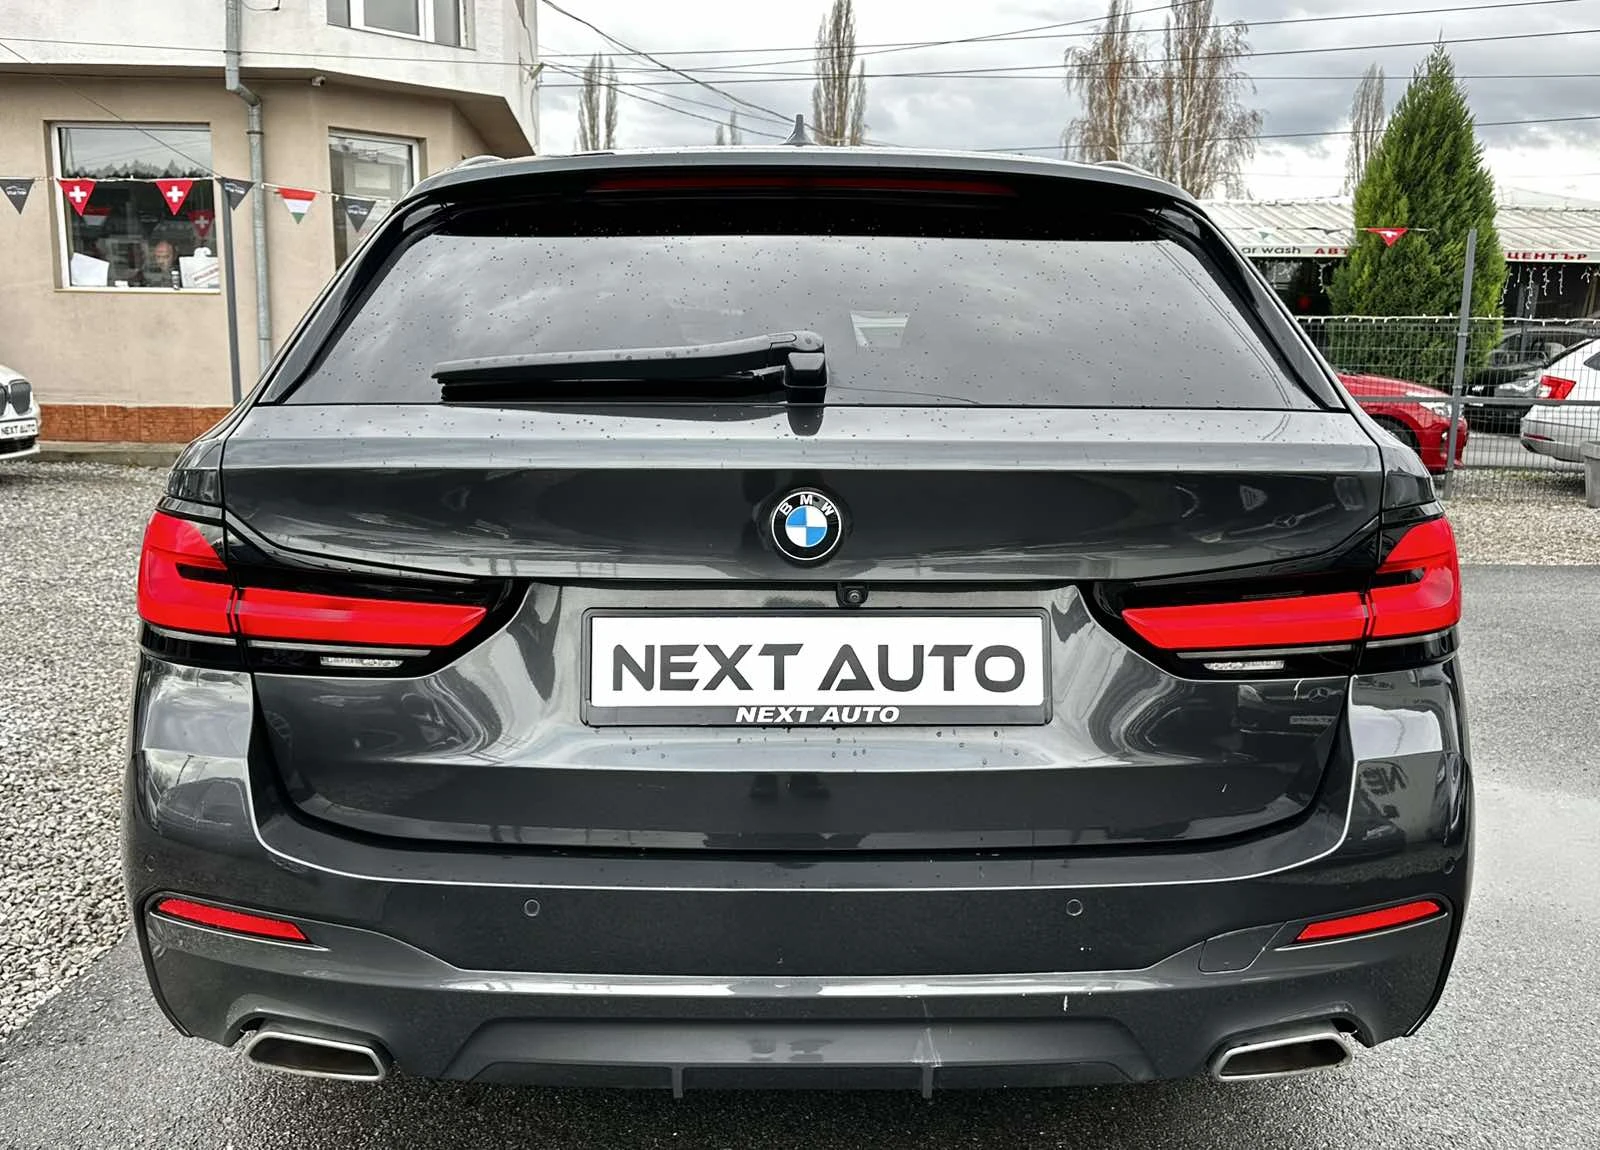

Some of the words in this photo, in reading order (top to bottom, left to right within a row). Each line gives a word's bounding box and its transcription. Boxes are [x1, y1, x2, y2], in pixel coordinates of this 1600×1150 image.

[1241, 246, 1257, 255] ar
[1261, 245, 1302, 255] wash
[1314, 247, 1349, 256] АВТ
[1507, 252, 1588, 260] ЦЕНТЪР
[779, 494, 835, 517] BMW
[612, 643, 804, 692] NEXT
[817, 643, 1026, 693] AUTO
[735, 706, 815, 723] NEXT
[820, 706, 900, 723] AUTO
